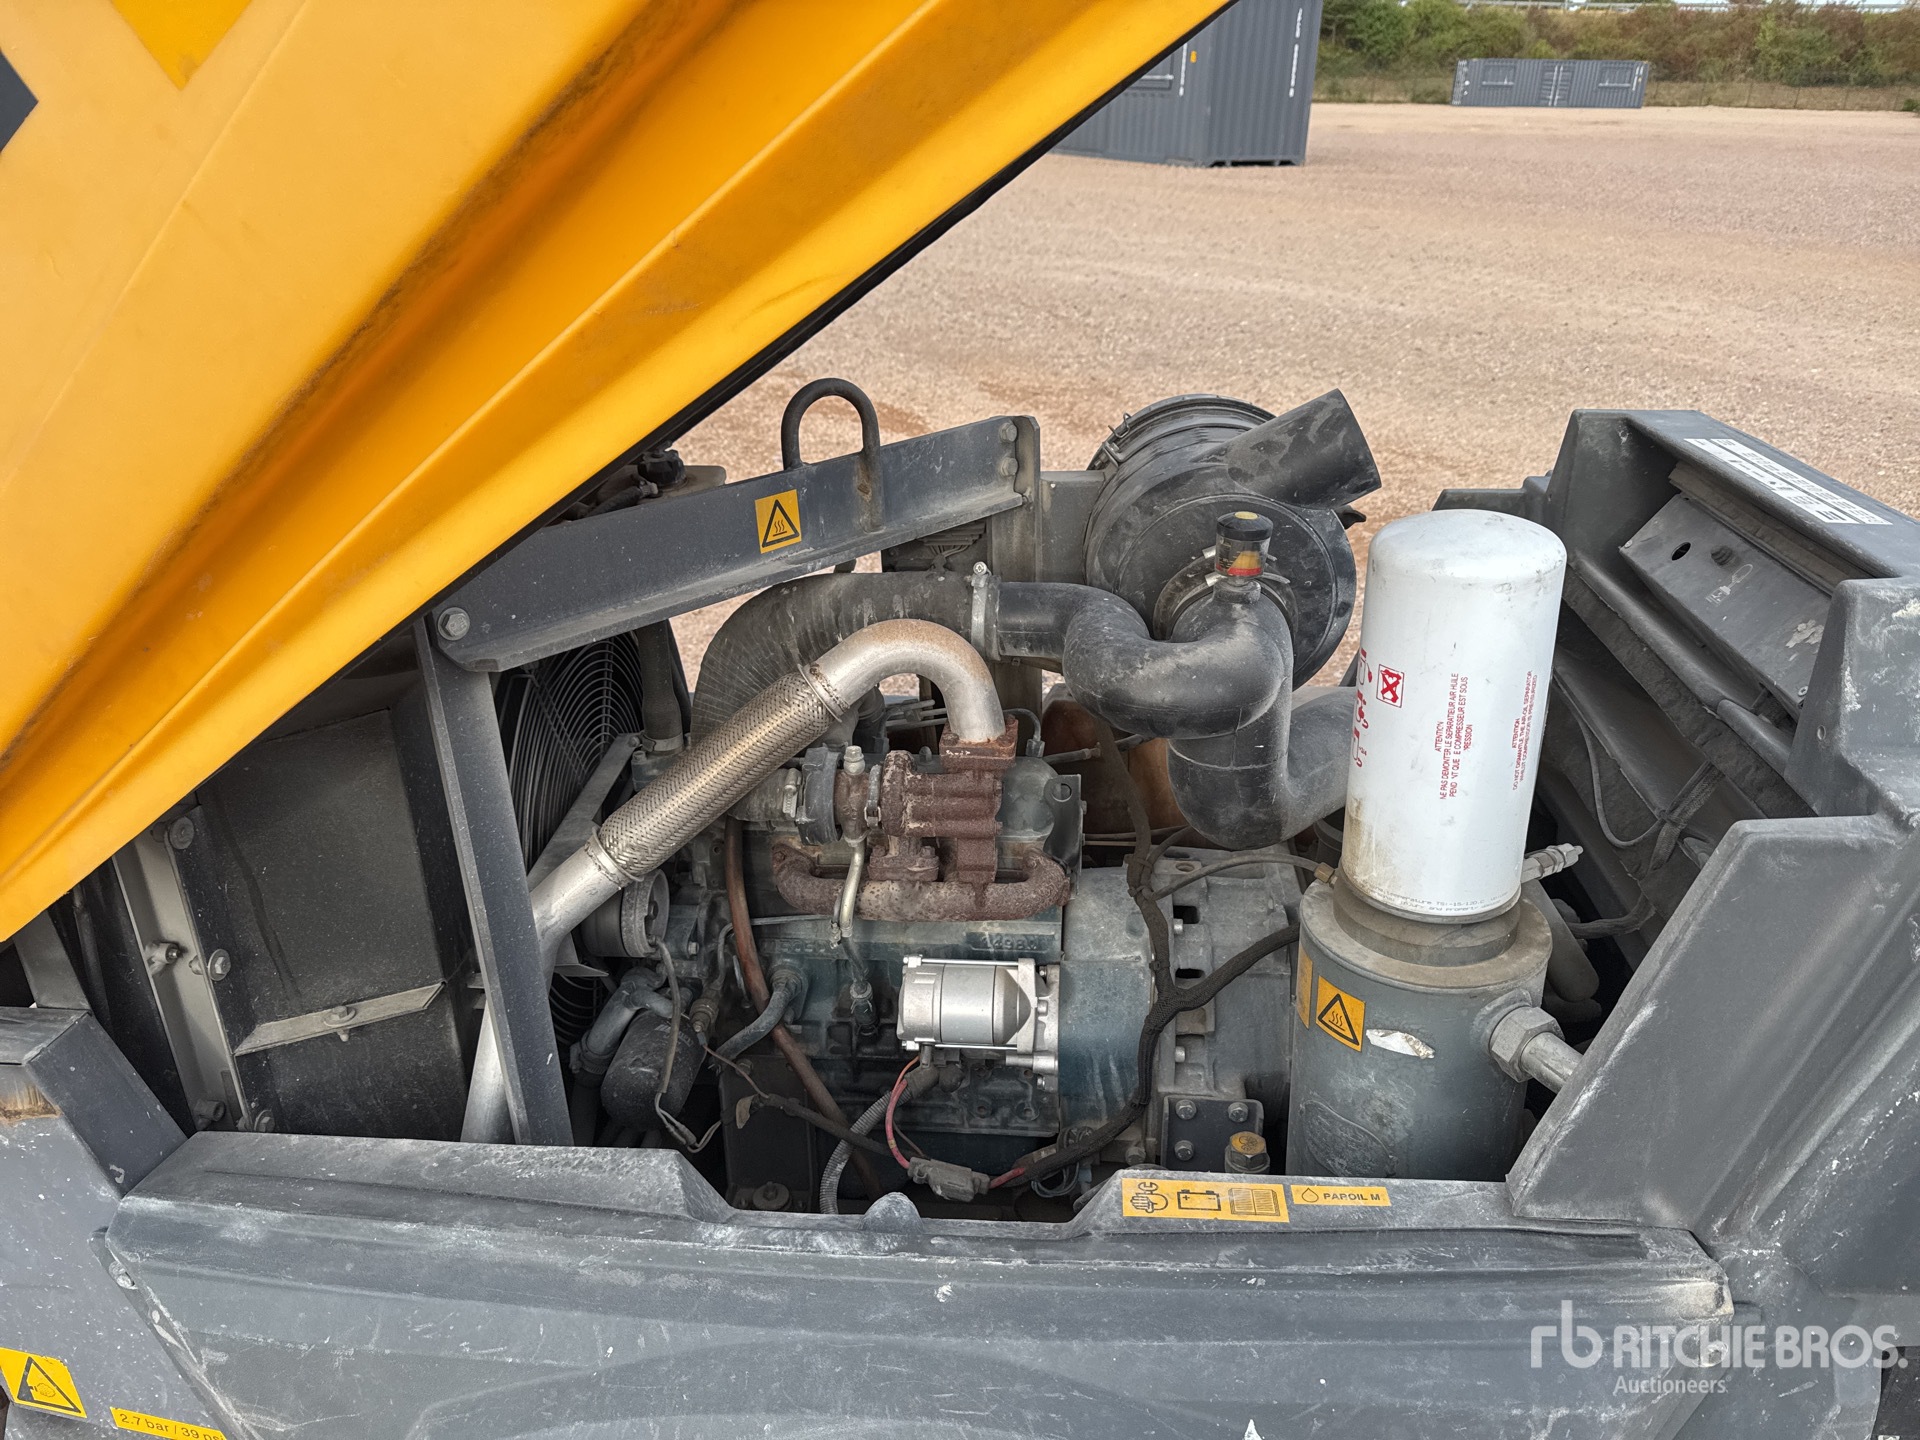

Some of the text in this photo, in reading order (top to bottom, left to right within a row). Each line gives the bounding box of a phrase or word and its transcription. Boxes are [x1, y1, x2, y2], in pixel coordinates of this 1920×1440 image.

[1450, 673, 1458, 690] HUILE
[1459, 677, 1468, 694] SOUS
[1449, 691, 1457, 701] AIR
[1458, 694, 1467, 706] EST
[1454, 706, 1465, 750] COMPRESSEUR
[1512, 718, 1520, 749] ATTENTION
[1434, 721, 1445, 752] ATTENTION
[1444, 740, 1452, 748] LE
[1452, 759, 1460, 771] QUE
[1440, 780, 1448, 791] PAS
[1323, 1193, 1381, 1201] PAROIL M
[119, 1413, 141, 1426] 2.7
[145, 1418, 169, 1432] bar
[181, 1427, 200, 1439] 39
